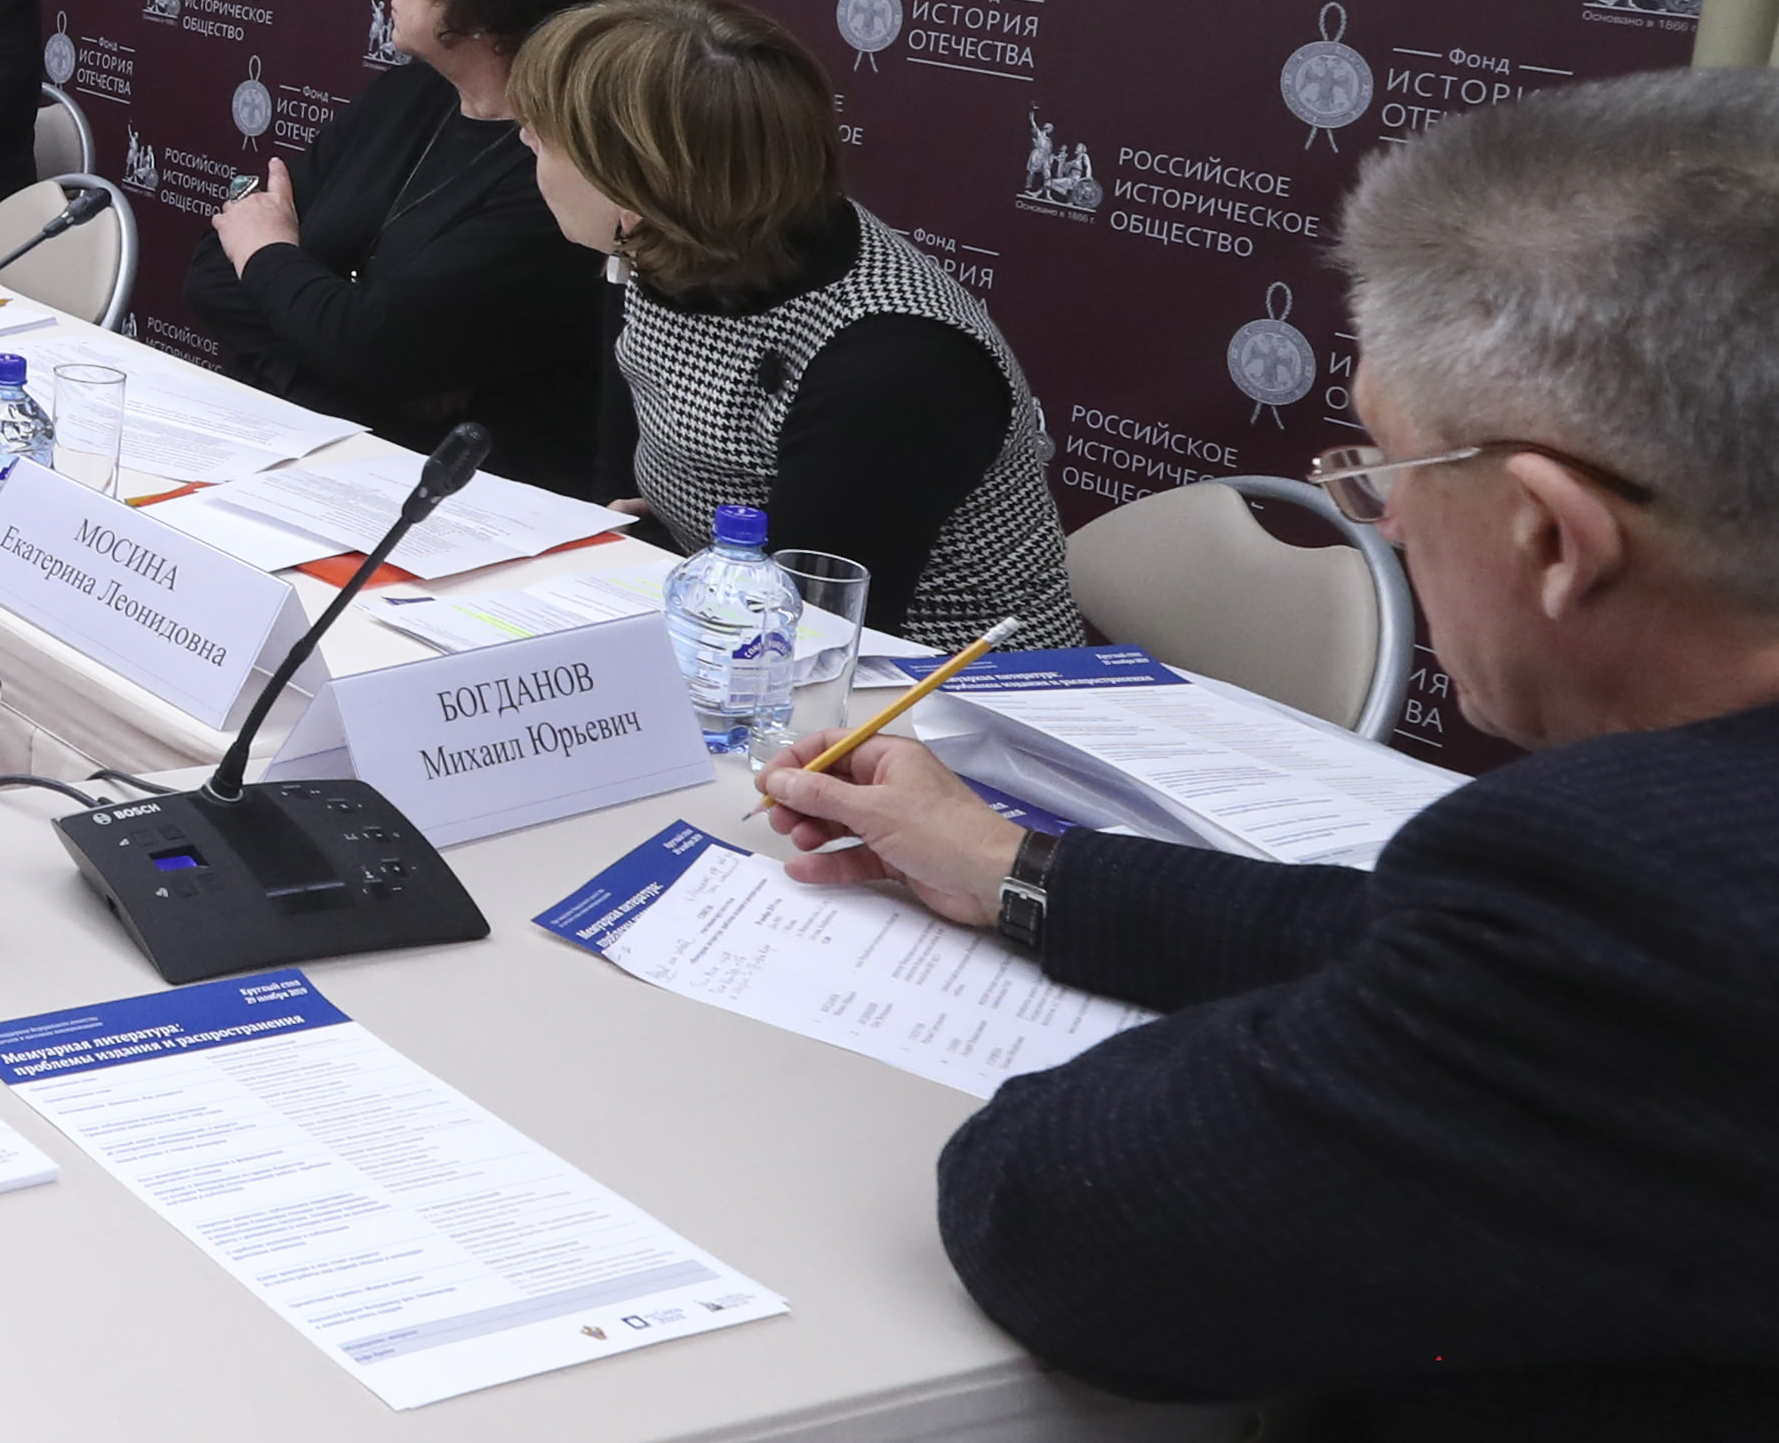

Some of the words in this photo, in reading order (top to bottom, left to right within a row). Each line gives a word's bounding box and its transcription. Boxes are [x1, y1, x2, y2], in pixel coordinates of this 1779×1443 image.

[912, 0, 1039, 37] ИСТОРИЯ
[908, 29, 1034, 69] ОТЕЧЕСТВА
[1119, 146, 1291, 198] РОССИЙСКОЕ
[1110, 211, 1253, 258] ОБЩЕСТВО
[1115, 178, 1320, 238] ИСТОРИЧЕСКОЕ
[73, 518, 181, 593] МОСИНА
[97, 576, 229, 667] Леонидовна
[436, 661, 596, 723] БОГДАНОВ
[420, 738, 524, 784] Михаил
[529, 708, 643, 764] Юрьевич
[113, 803, 161, 819] BOSCH
[1, 1040, 92, 1065] Мемуарная
[93, 1022, 184, 1049] литература:
[13, 1055, 95, 1077] проблемы
[99, 1042, 162, 1062] издания
[165, 1039, 175, 1049] и
[179, 1014, 305, 1047] распространения
